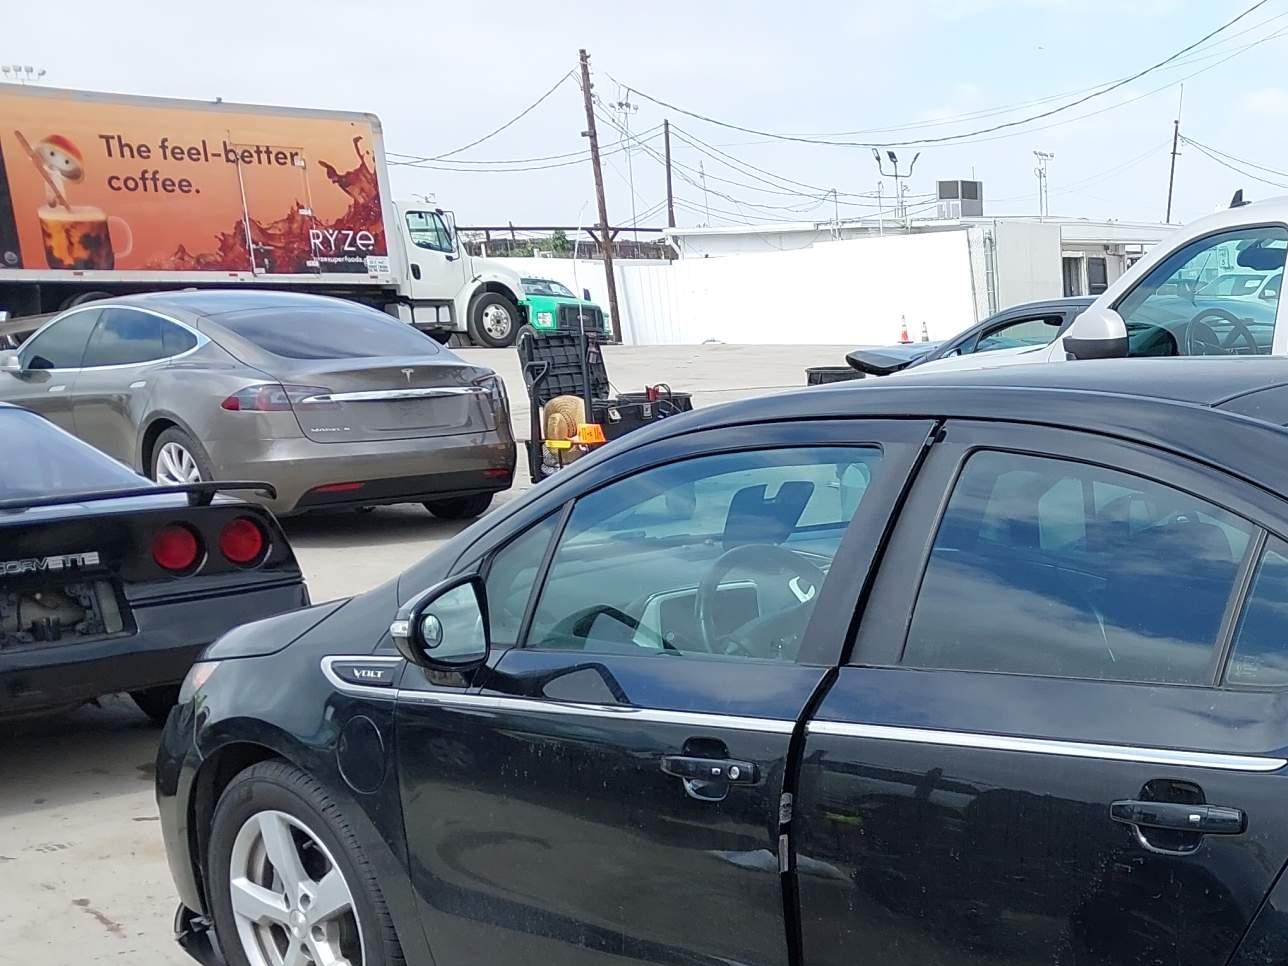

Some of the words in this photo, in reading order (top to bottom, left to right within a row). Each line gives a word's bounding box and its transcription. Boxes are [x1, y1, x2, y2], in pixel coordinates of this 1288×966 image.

[98, 134, 152, 160] The
[158, 137, 300, 167] feel-better
[107, 168, 201, 194] coffee.
[353, 667, 385, 679] VOLT
